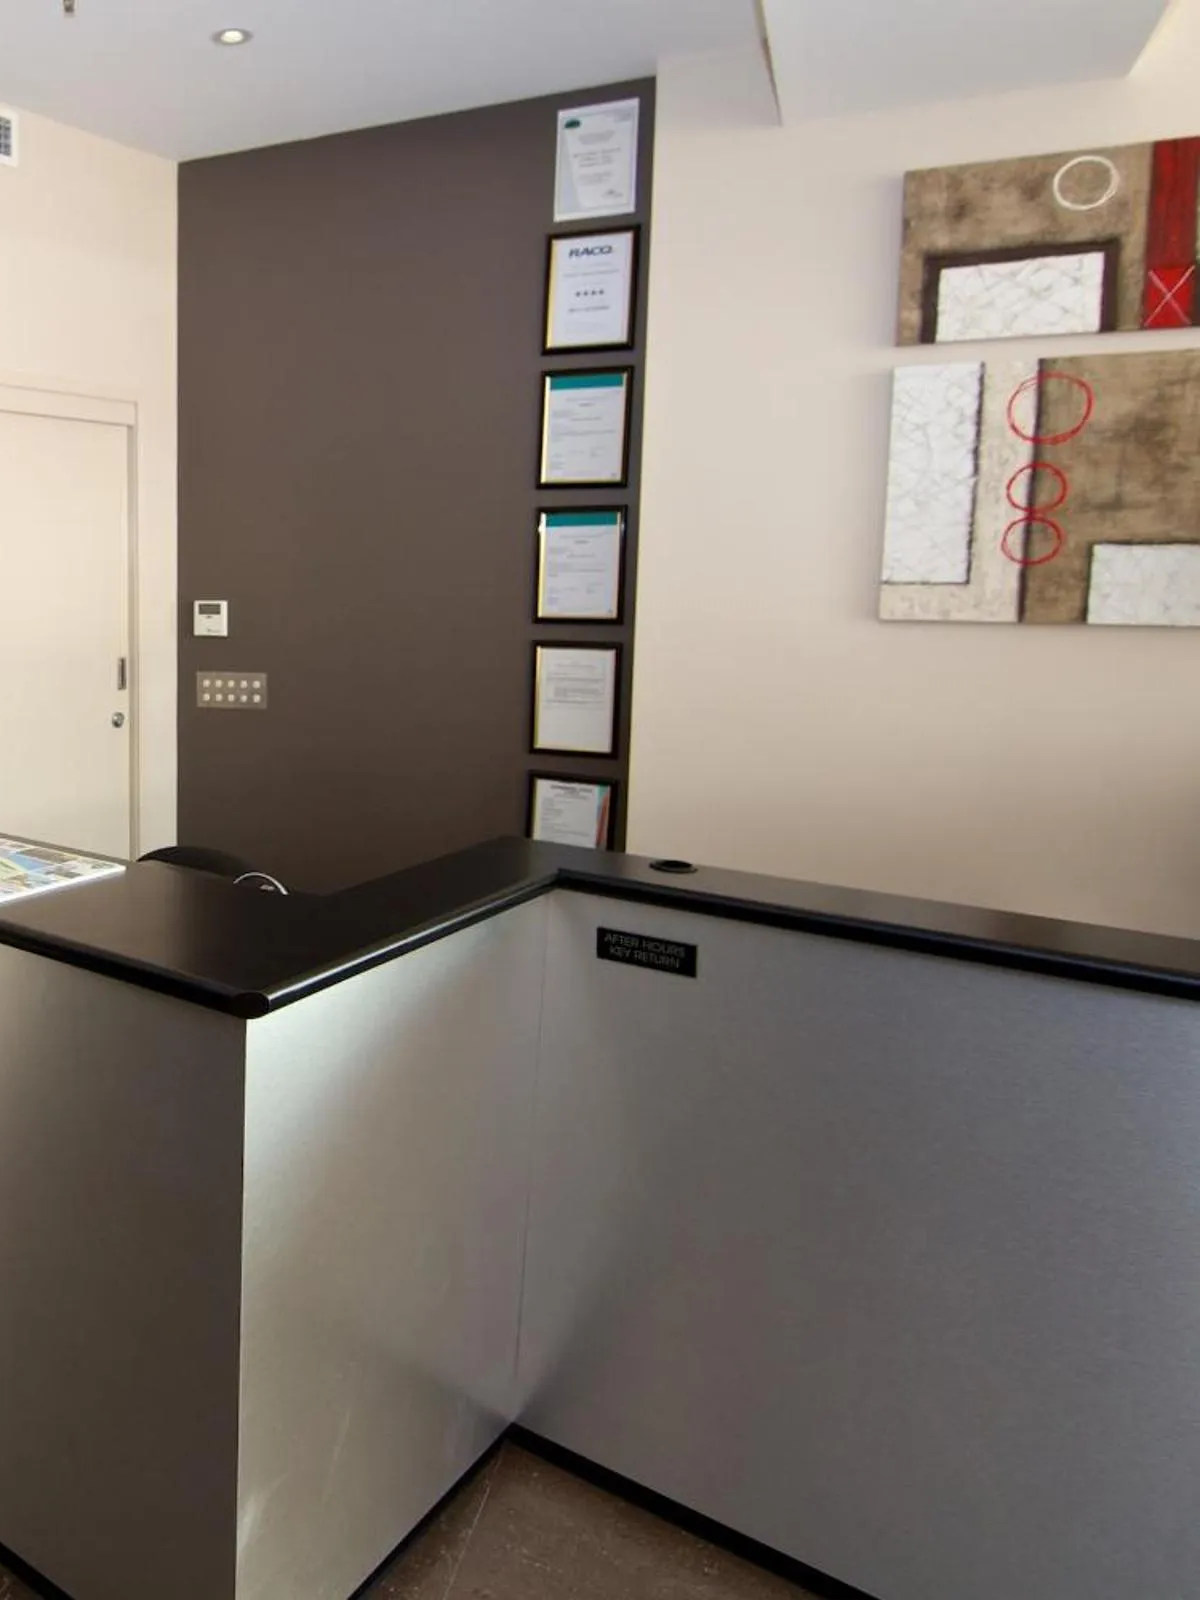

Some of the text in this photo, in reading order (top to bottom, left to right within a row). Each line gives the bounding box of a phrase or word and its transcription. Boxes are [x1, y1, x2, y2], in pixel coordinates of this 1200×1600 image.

[604, 932, 686, 959] AFTER HOURS
[609, 945, 680, 969] KEY RETURN
